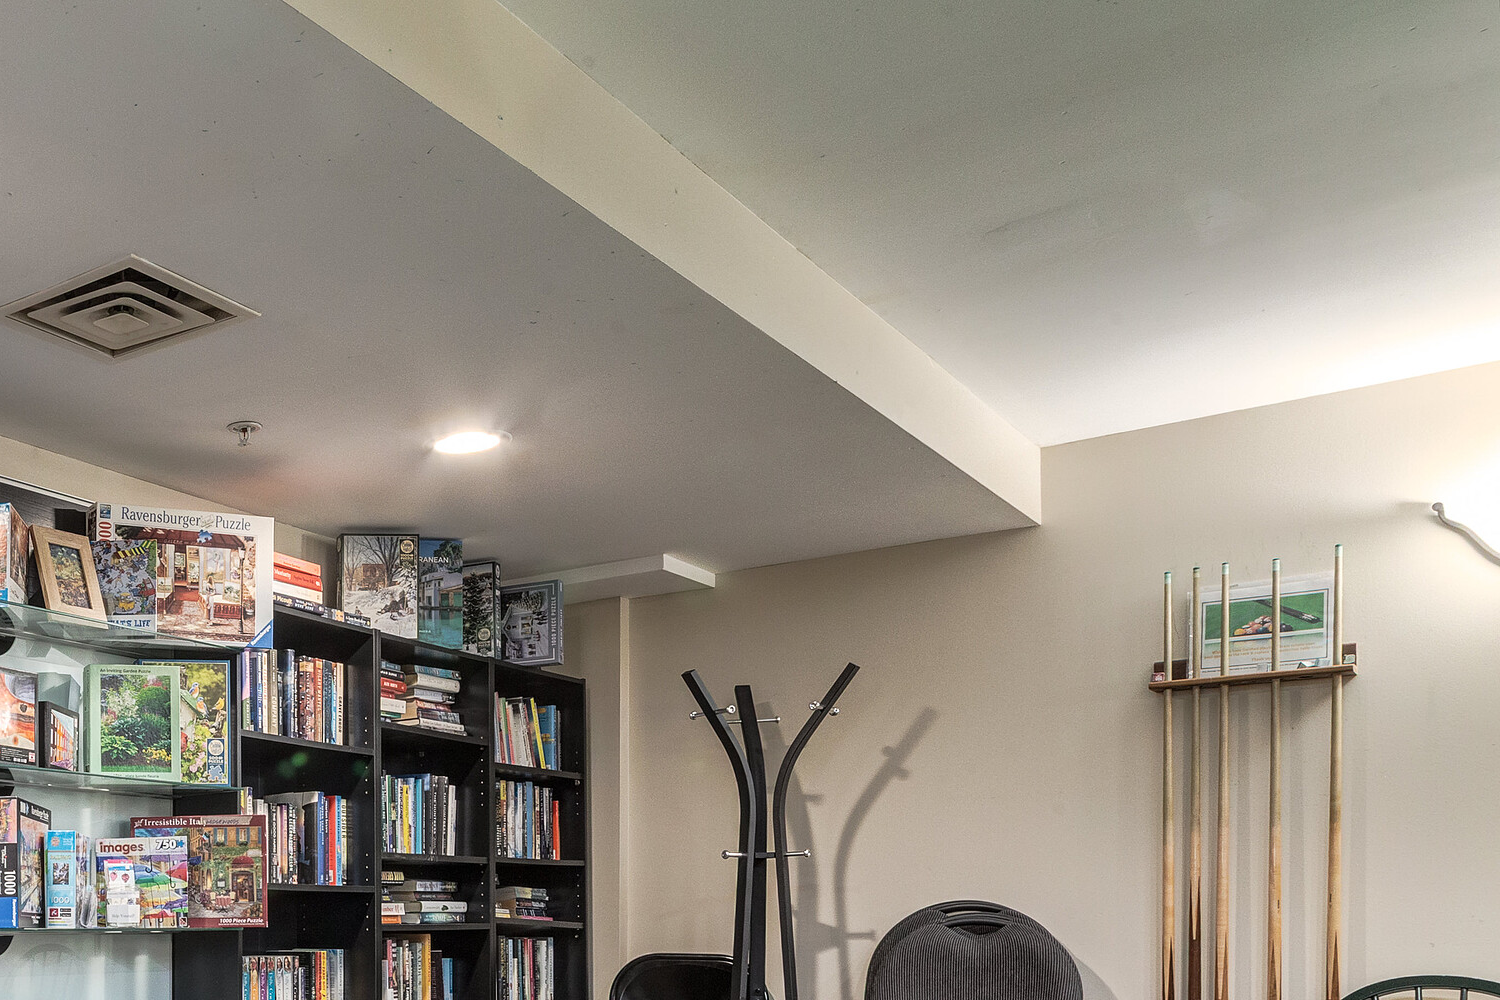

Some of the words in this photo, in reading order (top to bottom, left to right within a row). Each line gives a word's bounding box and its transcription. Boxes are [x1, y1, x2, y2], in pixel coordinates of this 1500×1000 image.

[121, 506, 200, 528] Ravensburger
[215, 516, 251, 531] Puzzle
[134, 619, 152, 628] LIFE
[144, 818, 188, 826] Irresistible
[189, 818, 207, 828] Italy
[100, 842, 144, 854] images
[155, 838, 177, 850] 750
[4, 870, 16, 895] 1000
